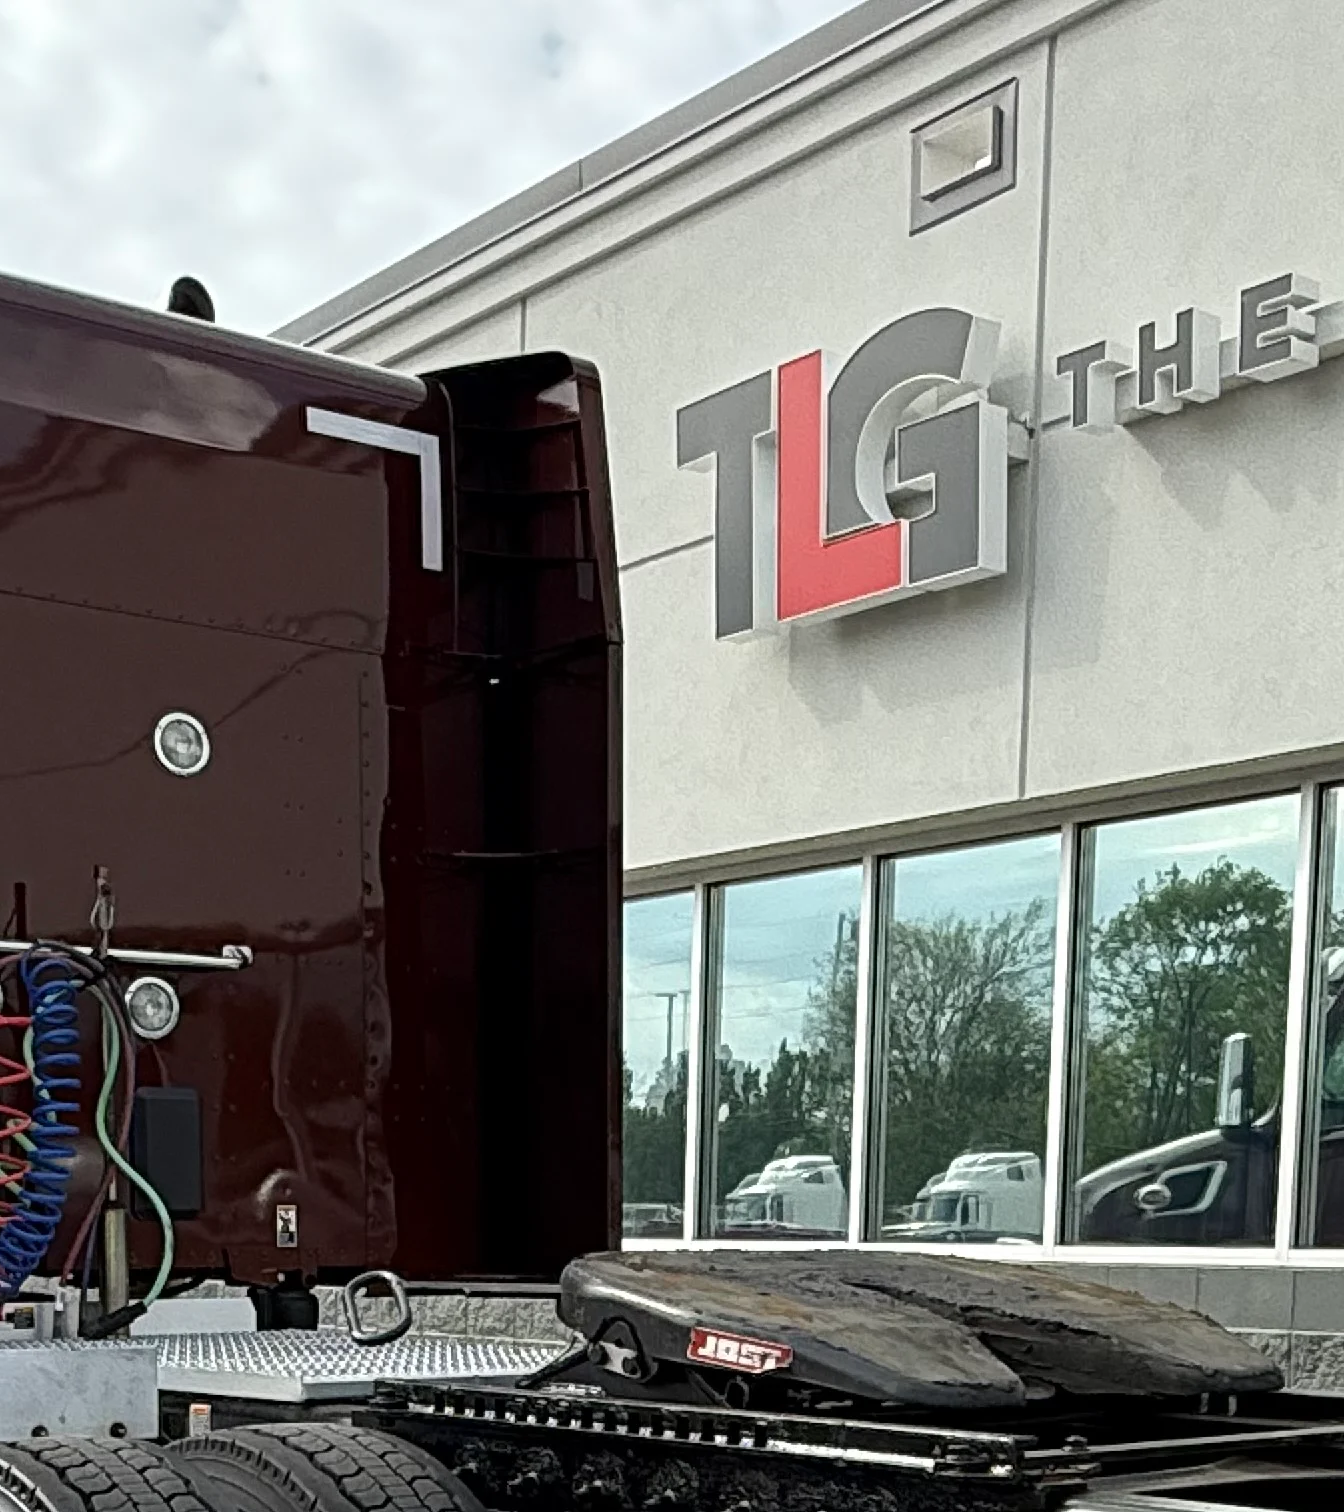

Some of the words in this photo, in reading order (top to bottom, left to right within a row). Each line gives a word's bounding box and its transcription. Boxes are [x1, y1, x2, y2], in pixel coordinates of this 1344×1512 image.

[1056, 273, 1297, 428] THE
[676, 306, 984, 641] TLG
[697, 1335, 782, 1370] JOST
